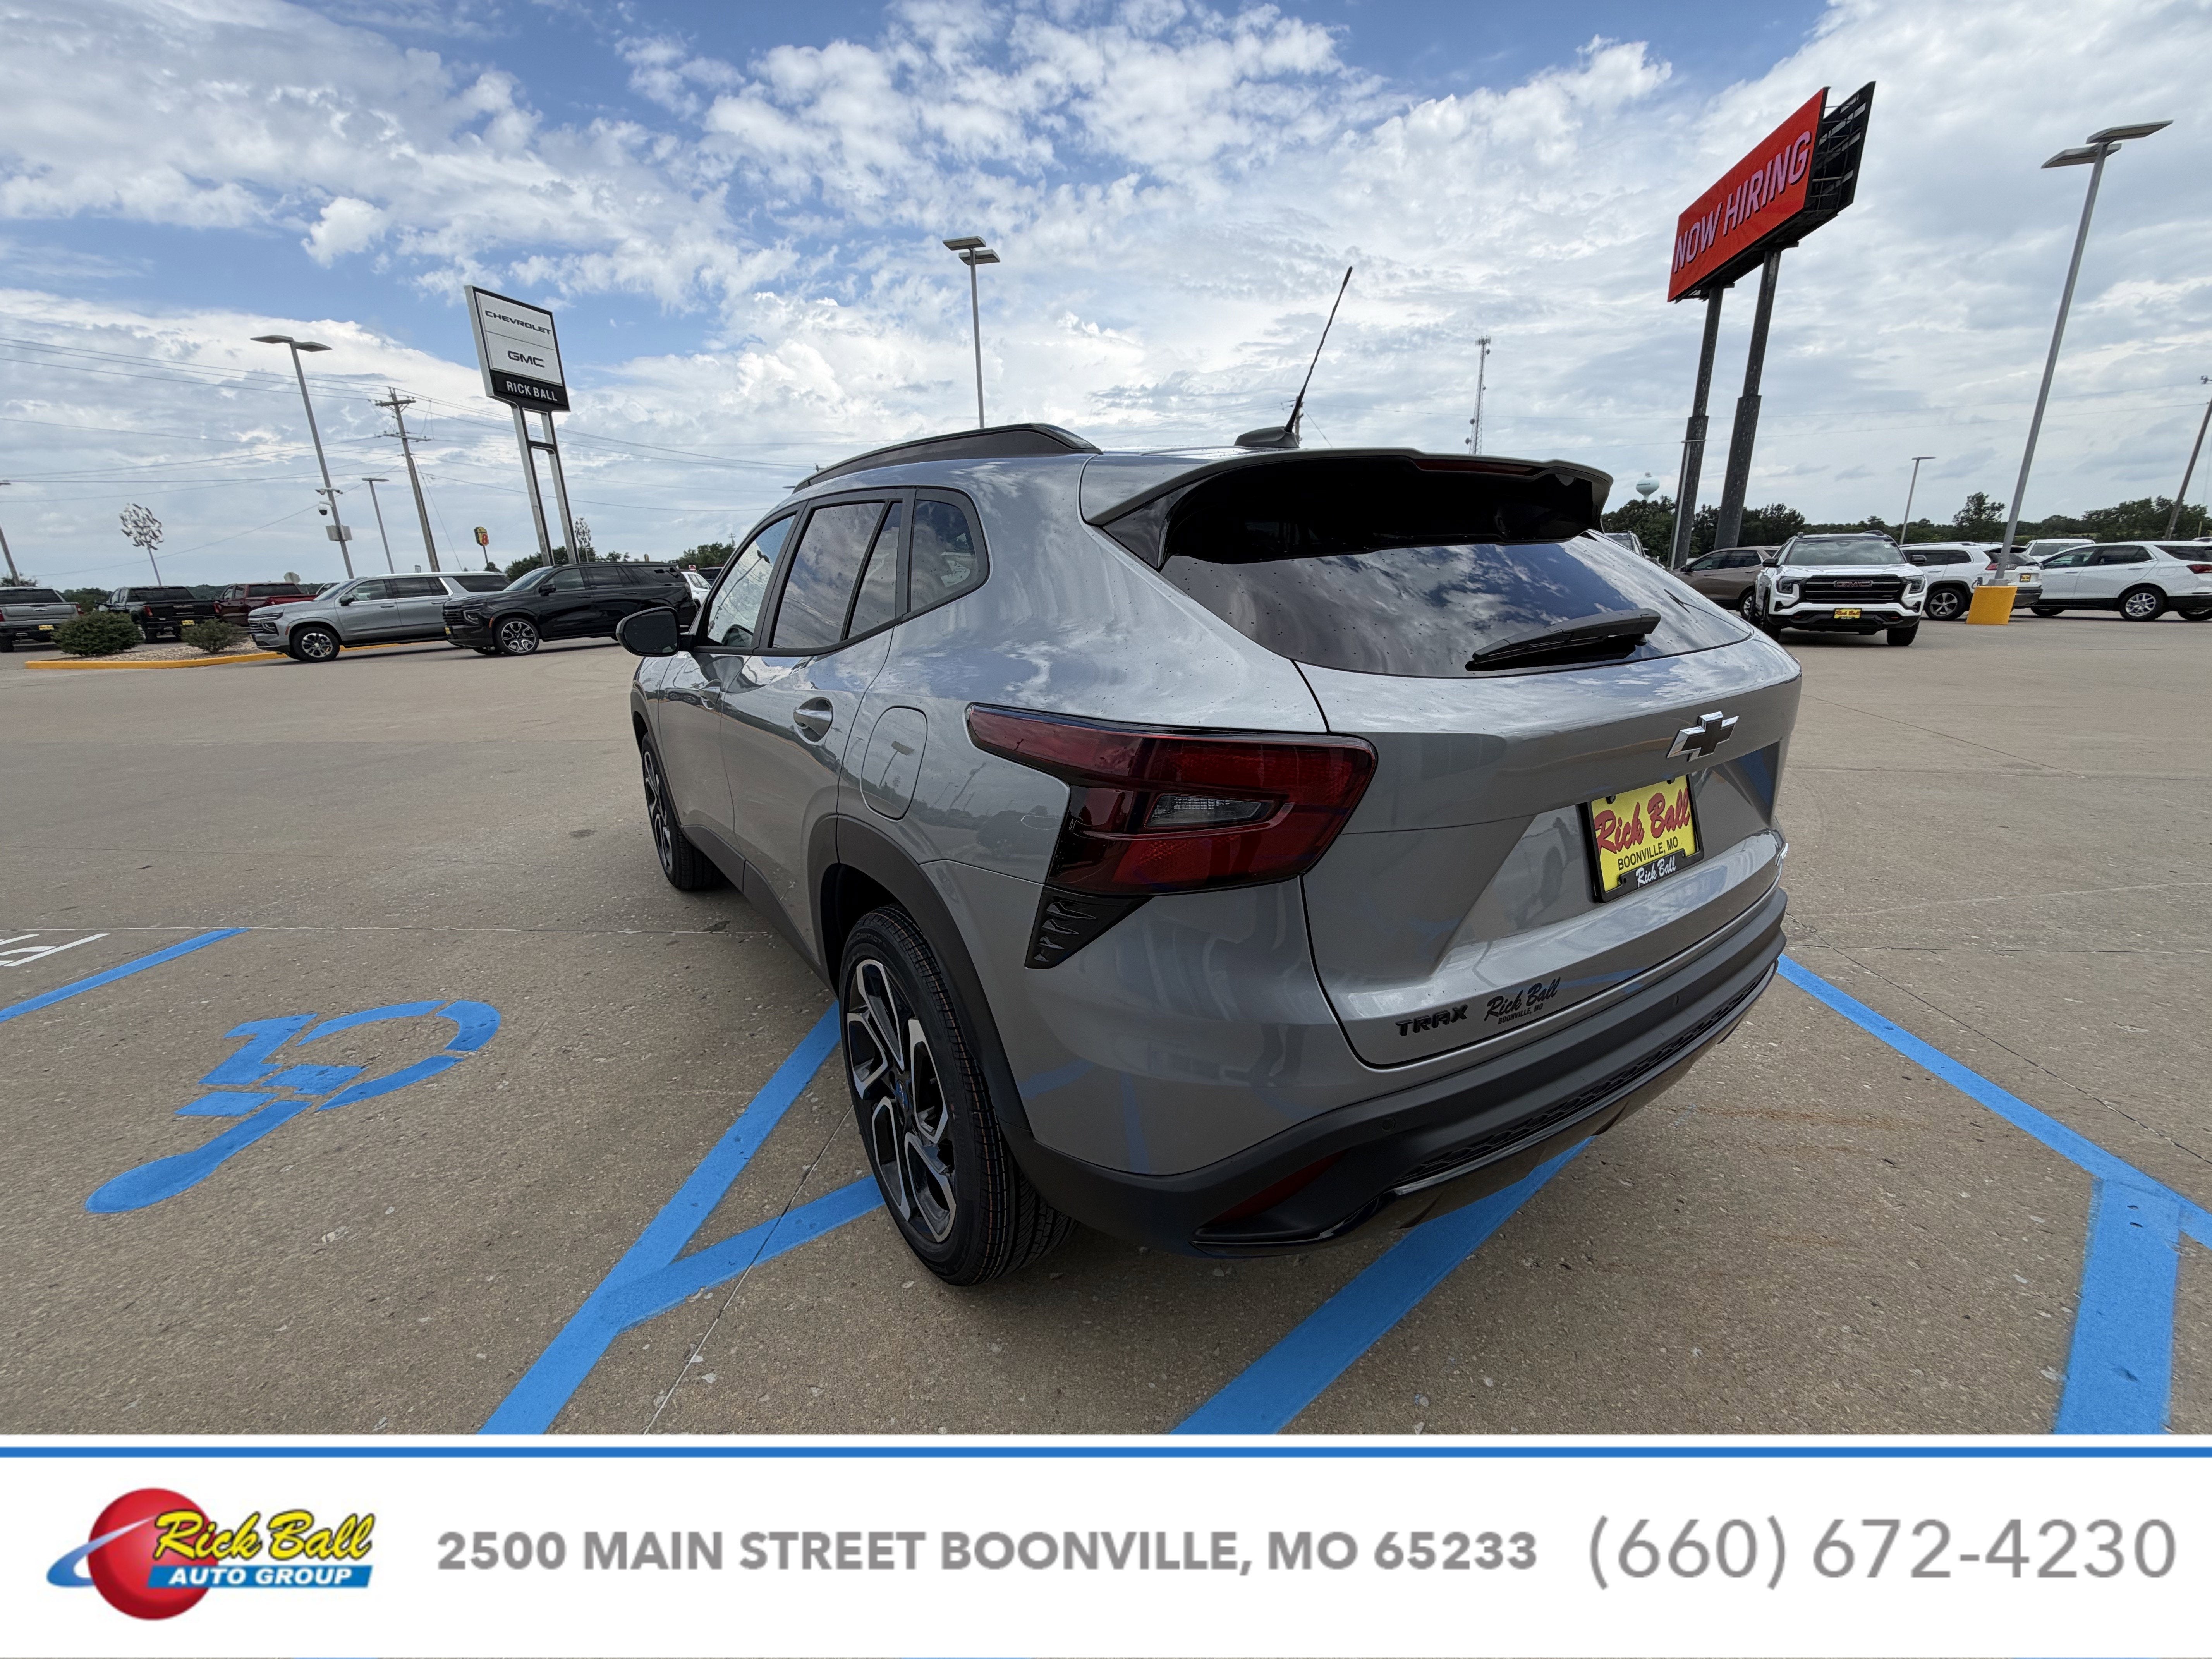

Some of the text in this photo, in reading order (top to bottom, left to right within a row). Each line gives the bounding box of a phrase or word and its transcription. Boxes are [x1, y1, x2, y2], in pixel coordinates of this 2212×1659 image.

[1674, 130, 1812, 273] NOW HIRING
[485, 310, 551, 334] CHEVROLET
[507, 350, 545, 368] GMC
[506, 380, 558, 401] RICK BALL
[1594, 787, 1690, 854] Rick Ball
[1618, 836, 1678, 871] BOONVILLE, MO
[1635, 855, 1676, 888] Rick Ball
[1484, 977, 1561, 1022] Rick Ball
[1498, 1003, 1544, 1025] BOONVILLE, MO
[1395, 1004, 1468, 1036] TRAX
